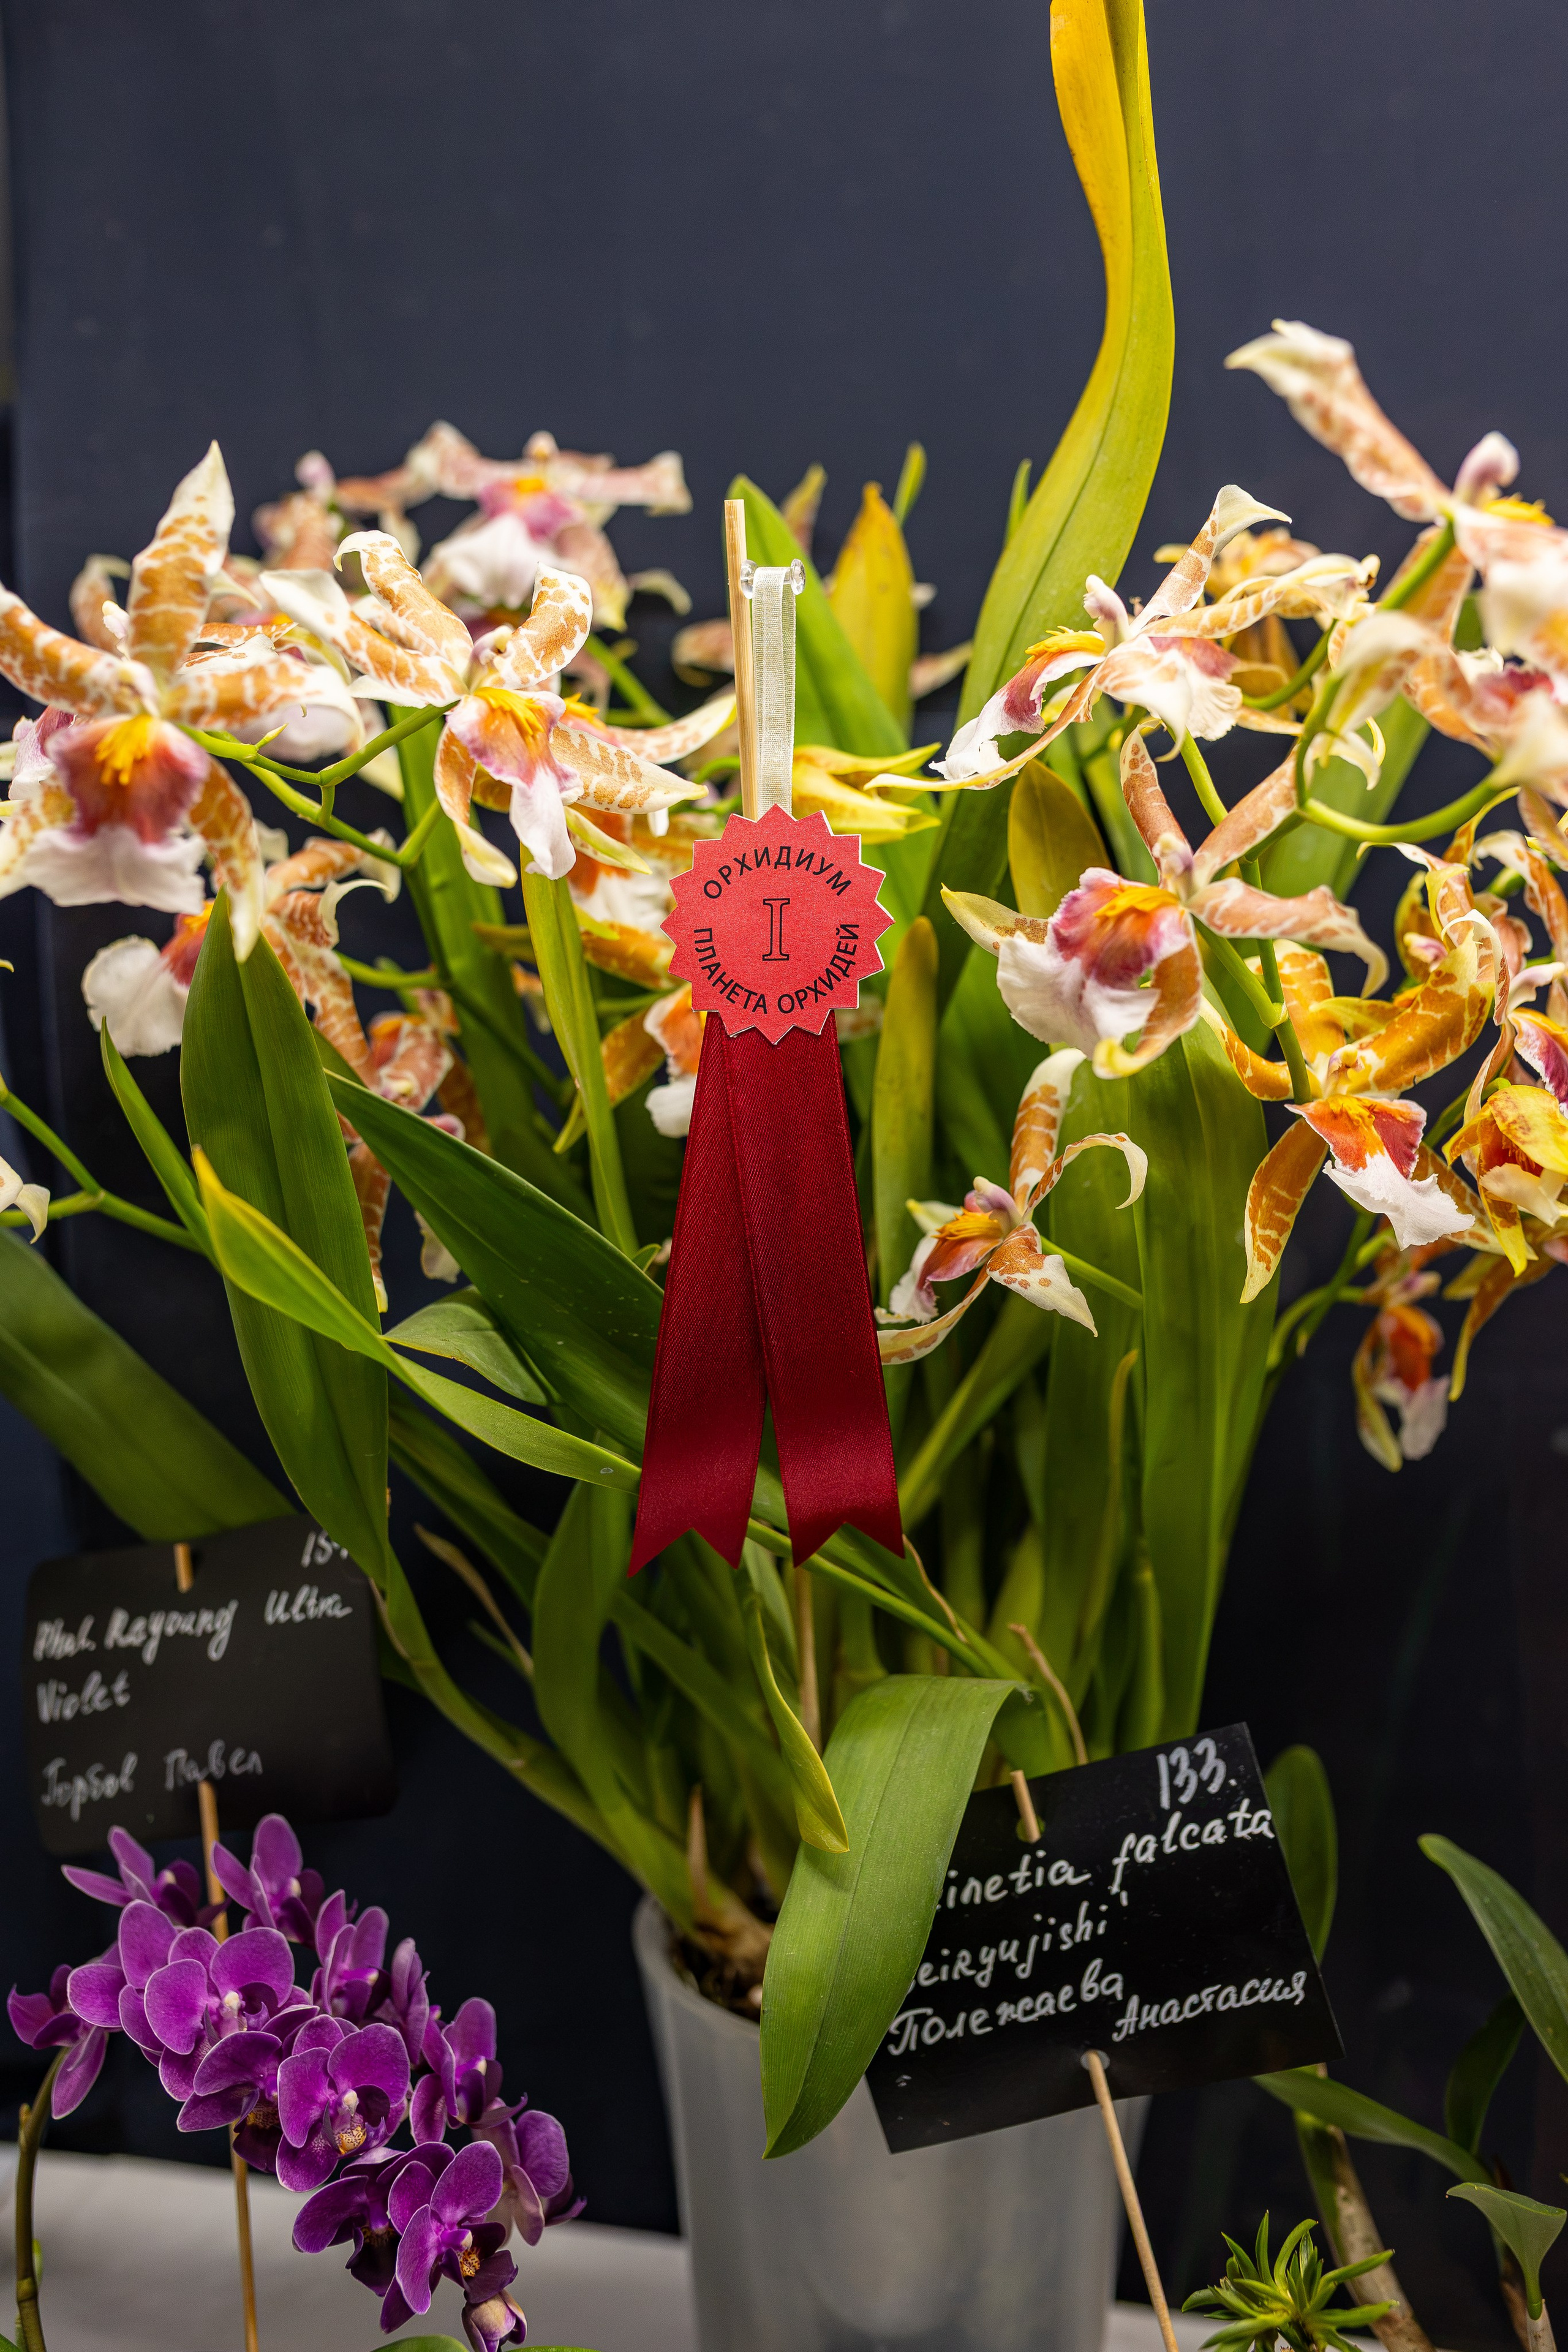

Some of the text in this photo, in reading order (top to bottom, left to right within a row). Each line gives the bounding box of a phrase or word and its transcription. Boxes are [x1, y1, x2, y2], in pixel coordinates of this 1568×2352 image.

[703, 846, 852, 899] ОРХИДИУМ
[762, 898, 790, 961] I
[693, 924, 860, 1014] ПЛАНЕТА ОРХИДЕЙ
[36, 1670, 131, 1725] Violet
[936, 1797, 1275, 1910] inetia falcata
[1111, 1970, 1307, 2043] Анастасия
